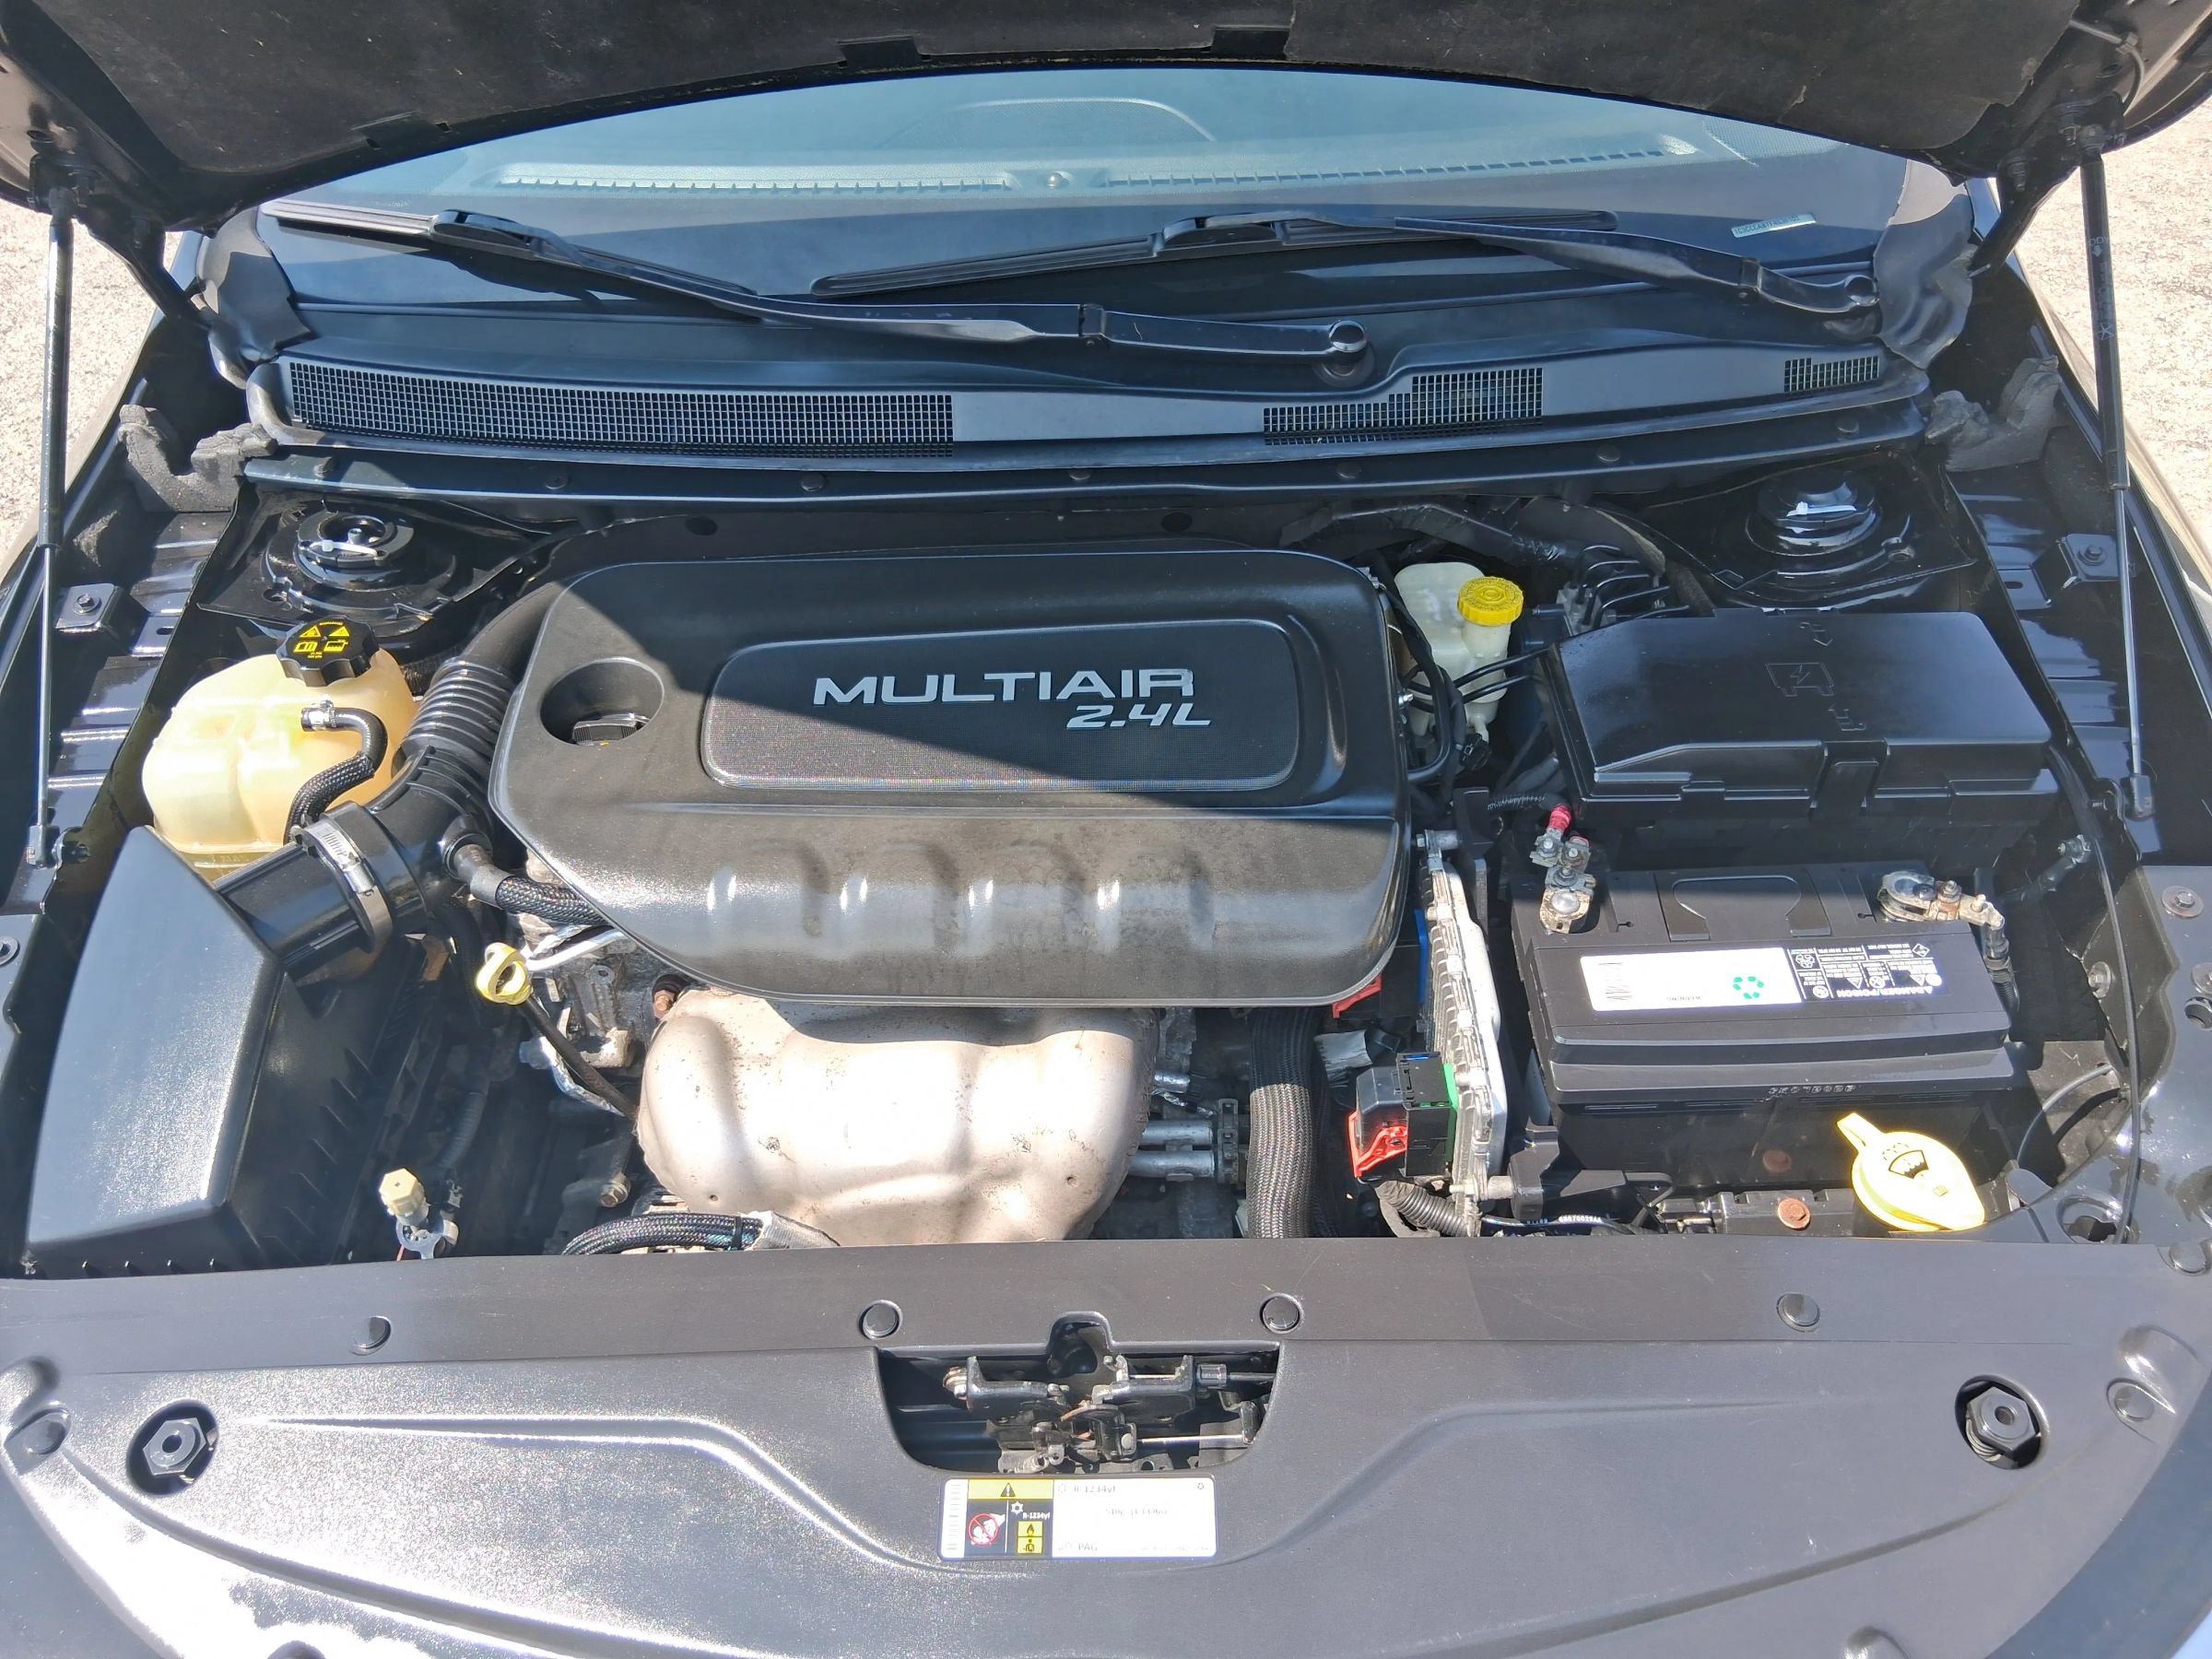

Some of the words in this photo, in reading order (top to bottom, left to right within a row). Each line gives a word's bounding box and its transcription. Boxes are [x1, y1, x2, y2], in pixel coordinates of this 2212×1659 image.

[813, 668, 1194, 706] MULTIAIR
[1066, 702, 1212, 729] 2.4L
[1077, 1542, 1098, 1552] PAG
